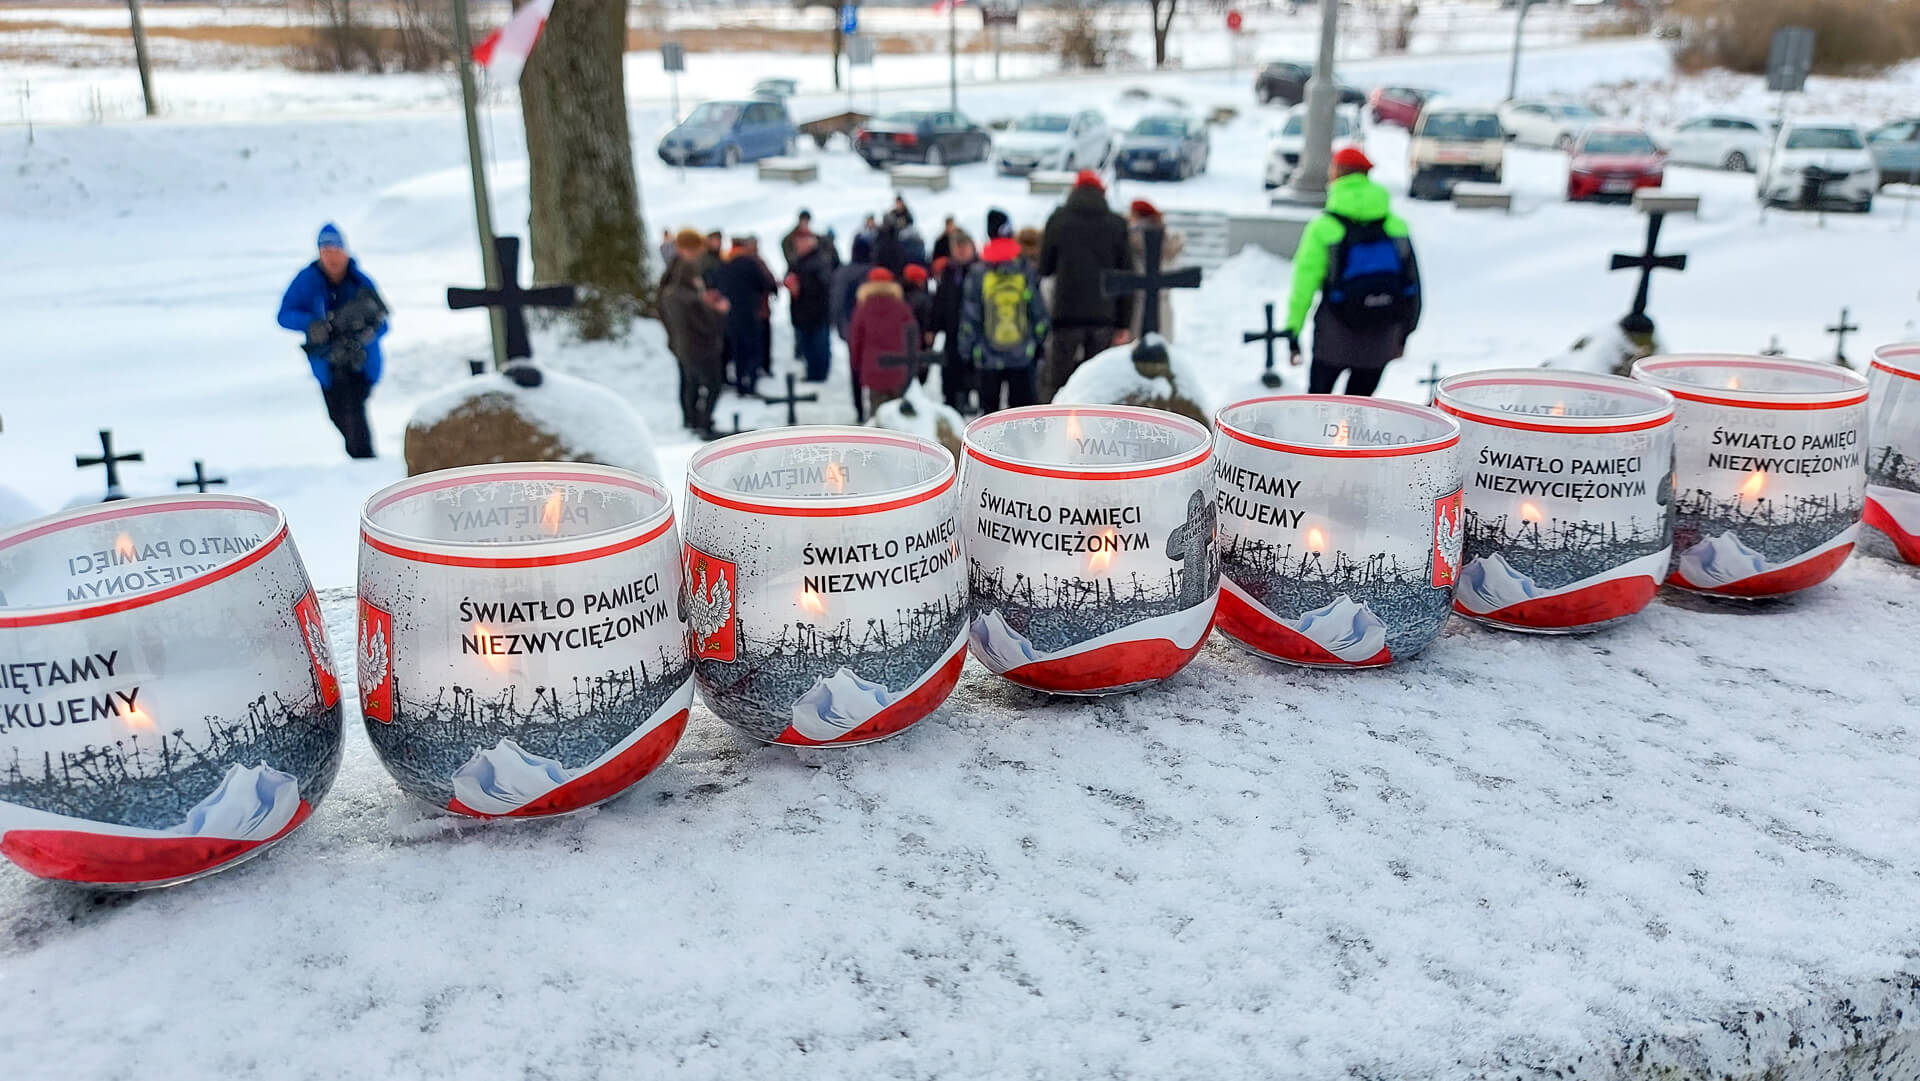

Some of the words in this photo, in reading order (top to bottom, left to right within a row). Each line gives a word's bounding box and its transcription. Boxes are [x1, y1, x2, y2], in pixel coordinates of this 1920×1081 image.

[1711, 426, 1796, 450] ŚWIATŁO
[1802, 429, 1857, 450] PAMIĘCI
[1479, 446, 1564, 475] ŚWIATŁO
[1571, 456, 1641, 477] PAMIĘCI
[1708, 453, 1860, 477] NIEZWYCIĘŻONYM
[980, 487, 1051, 523] ŚWIATŁO
[1059, 506, 1141, 529] PAMIĘCI
[1216, 487, 1306, 529] ĘKUJEMY
[1475, 472, 1646, 502] NIEZWYCIĘŻONYM
[803, 539, 899, 566] ŚWIATŁO
[905, 515, 956, 554] PAMIĘCI
[977, 517, 1150, 556] NIEZWYCIĘŻONYM
[804, 543, 962, 594] NIEZWYCIĘŻONYM
[459, 596, 575, 624] ŚWIATŁO
[584, 572, 660, 614] PAMIĘCI
[461, 599, 669, 656] NIEZWYCIĘŻONYM
[0, 650, 118, 695] IĘTAMY
[0, 686, 140, 734] KUJEMY
